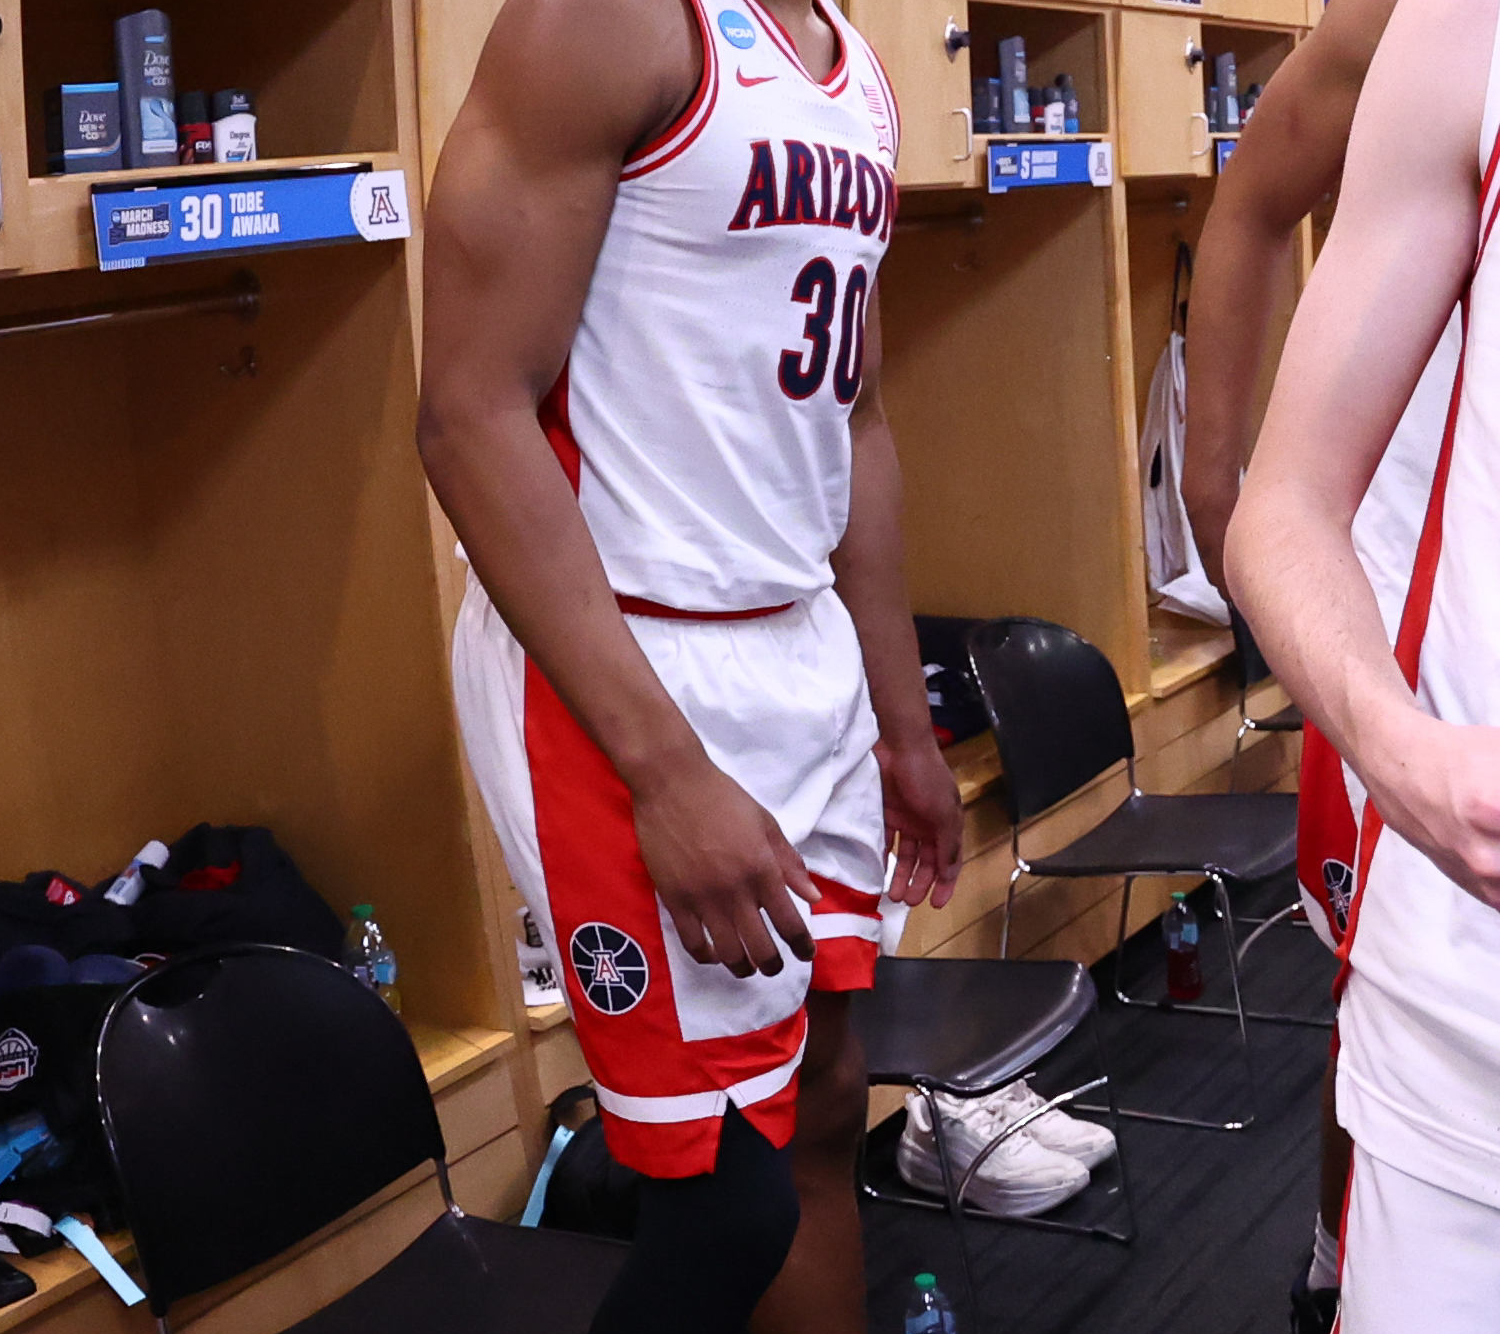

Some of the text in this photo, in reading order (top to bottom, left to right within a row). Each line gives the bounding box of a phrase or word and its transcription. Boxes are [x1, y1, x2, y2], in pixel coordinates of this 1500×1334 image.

[726, 25, 755, 41] NCAA
[228, 190, 265, 214] TOBE
[368, 186, 400, 225] A
[727, 139, 899, 245] ARIZON
[120, 208, 154, 224] MARCH
[126, 219, 170, 238] MADNESS
[180, 193, 223, 242] 30
[231, 212, 281, 238] AWAKA
[778, 255, 870, 406] 30
[592, 949, 625, 987] A
